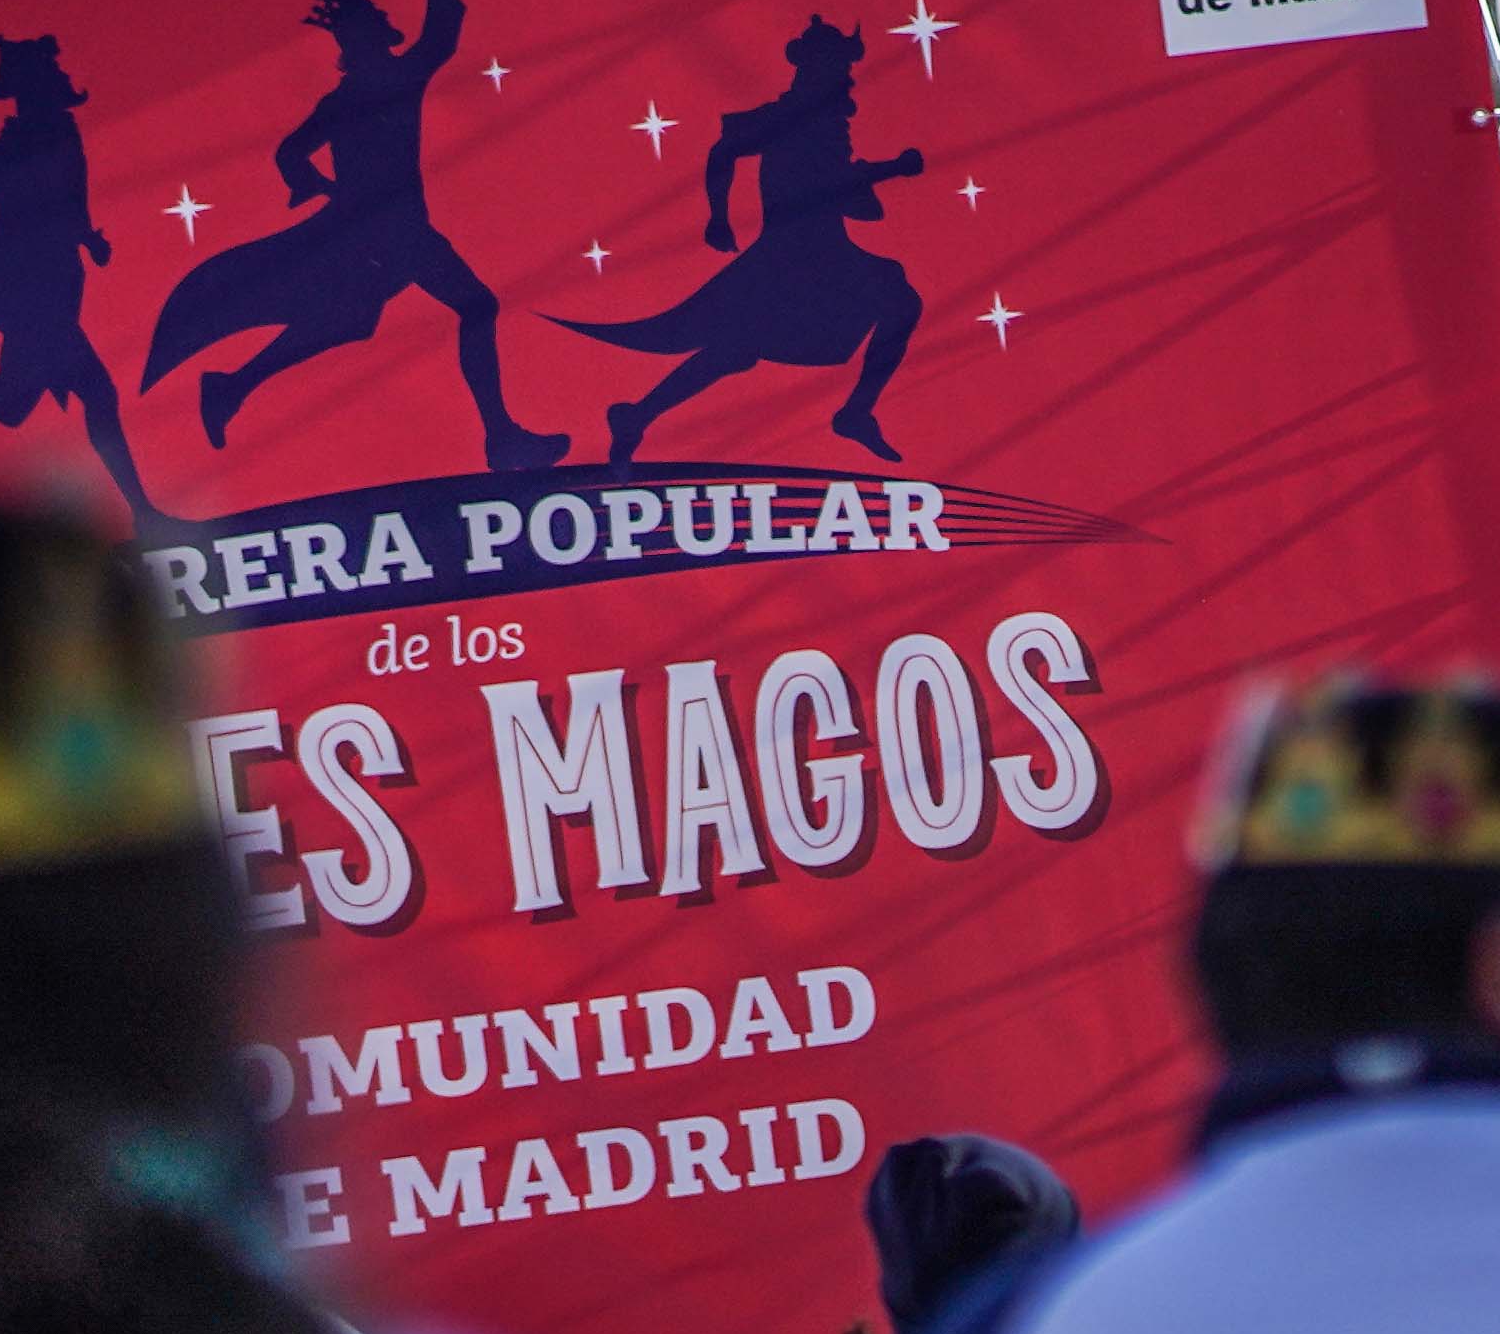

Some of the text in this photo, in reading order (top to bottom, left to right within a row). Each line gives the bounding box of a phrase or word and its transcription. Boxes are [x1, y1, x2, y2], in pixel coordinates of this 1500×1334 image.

[143, 479, 951, 617] RERA POPULAR
[367, 614, 526, 676] de los
[480, 611, 1099, 912] MAGOS
[232, 965, 878, 1124] OMUNIDAD
[273, 1097, 867, 1251] E MADRID
